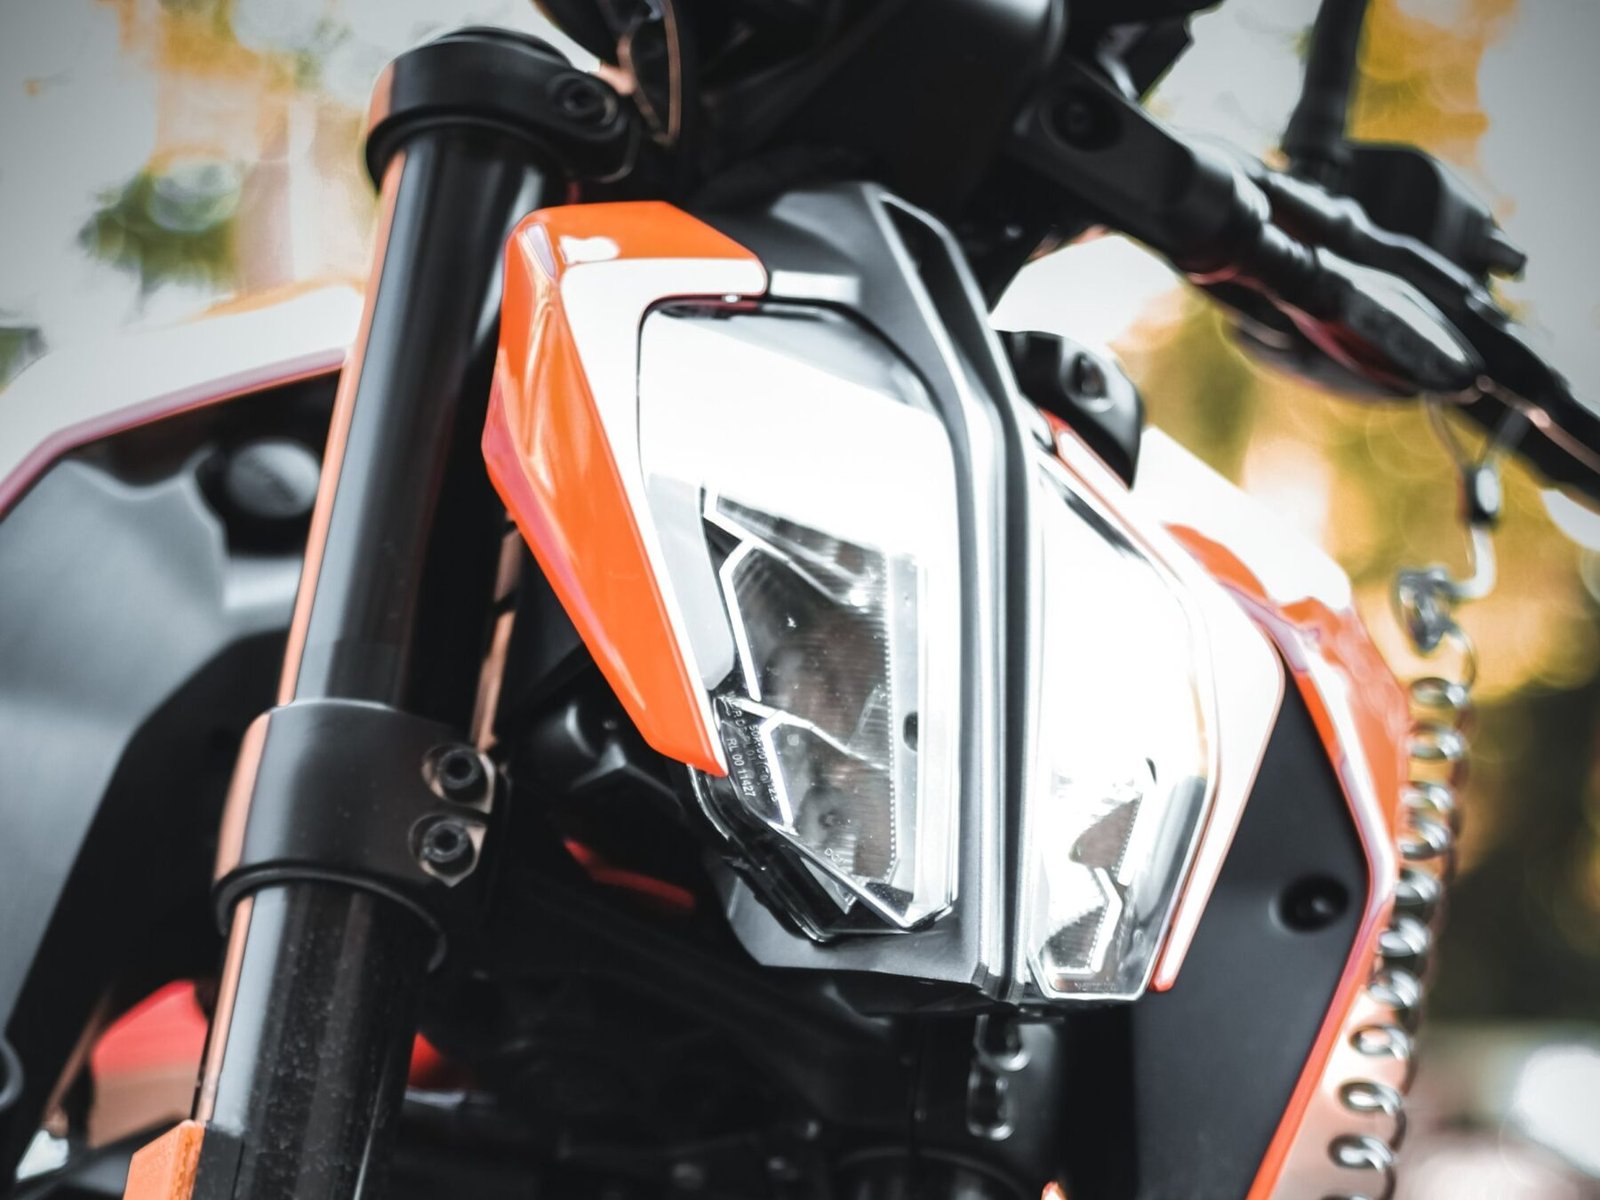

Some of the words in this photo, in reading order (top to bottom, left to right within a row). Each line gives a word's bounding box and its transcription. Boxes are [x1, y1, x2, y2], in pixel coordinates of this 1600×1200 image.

[727, 738, 738, 752] RL
[732, 754, 744, 766] 00
[738, 769, 756, 797] 11427
